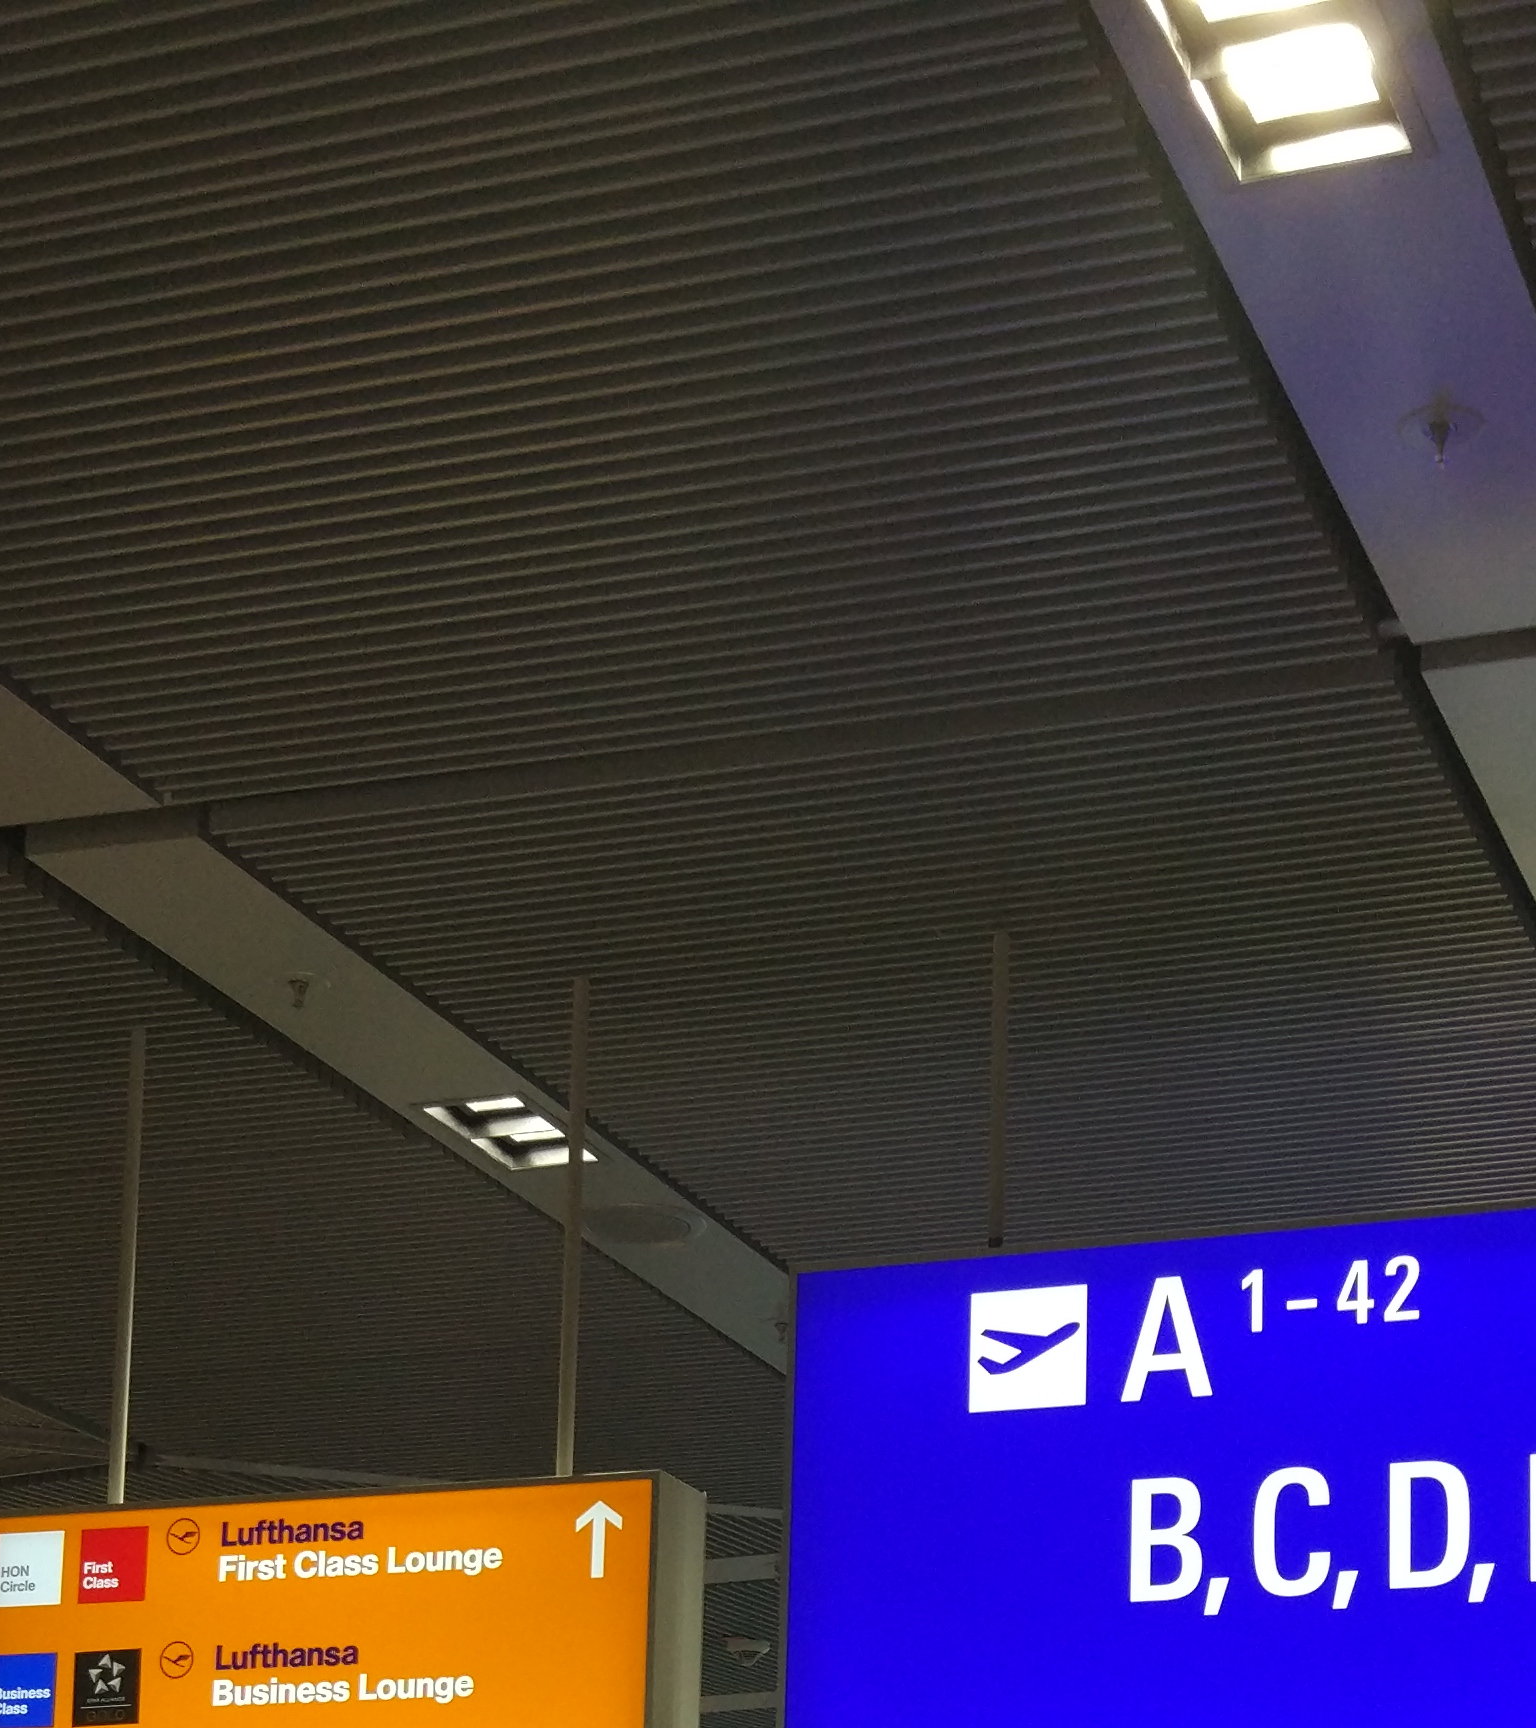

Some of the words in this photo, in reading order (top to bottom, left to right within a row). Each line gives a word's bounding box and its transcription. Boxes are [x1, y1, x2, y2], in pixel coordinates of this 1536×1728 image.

[1120, 1276, 1214, 1403] A
[220, 1516, 365, 1548] Lufthansa
[1, 1565, 30, 1578] HON
[83, 1561, 114, 1575] First
[217, 1551, 286, 1583] First
[293, 1548, 379, 1580] Class
[386, 1542, 504, 1577] Lounge
[0, 1580, 36, 1593] Circle
[82, 1577, 119, 1590] Class
[214, 1641, 360, 1671] Lufthansa
[211, 1673, 350, 1708] Business
[357, 1671, 475, 1705] Lounge
